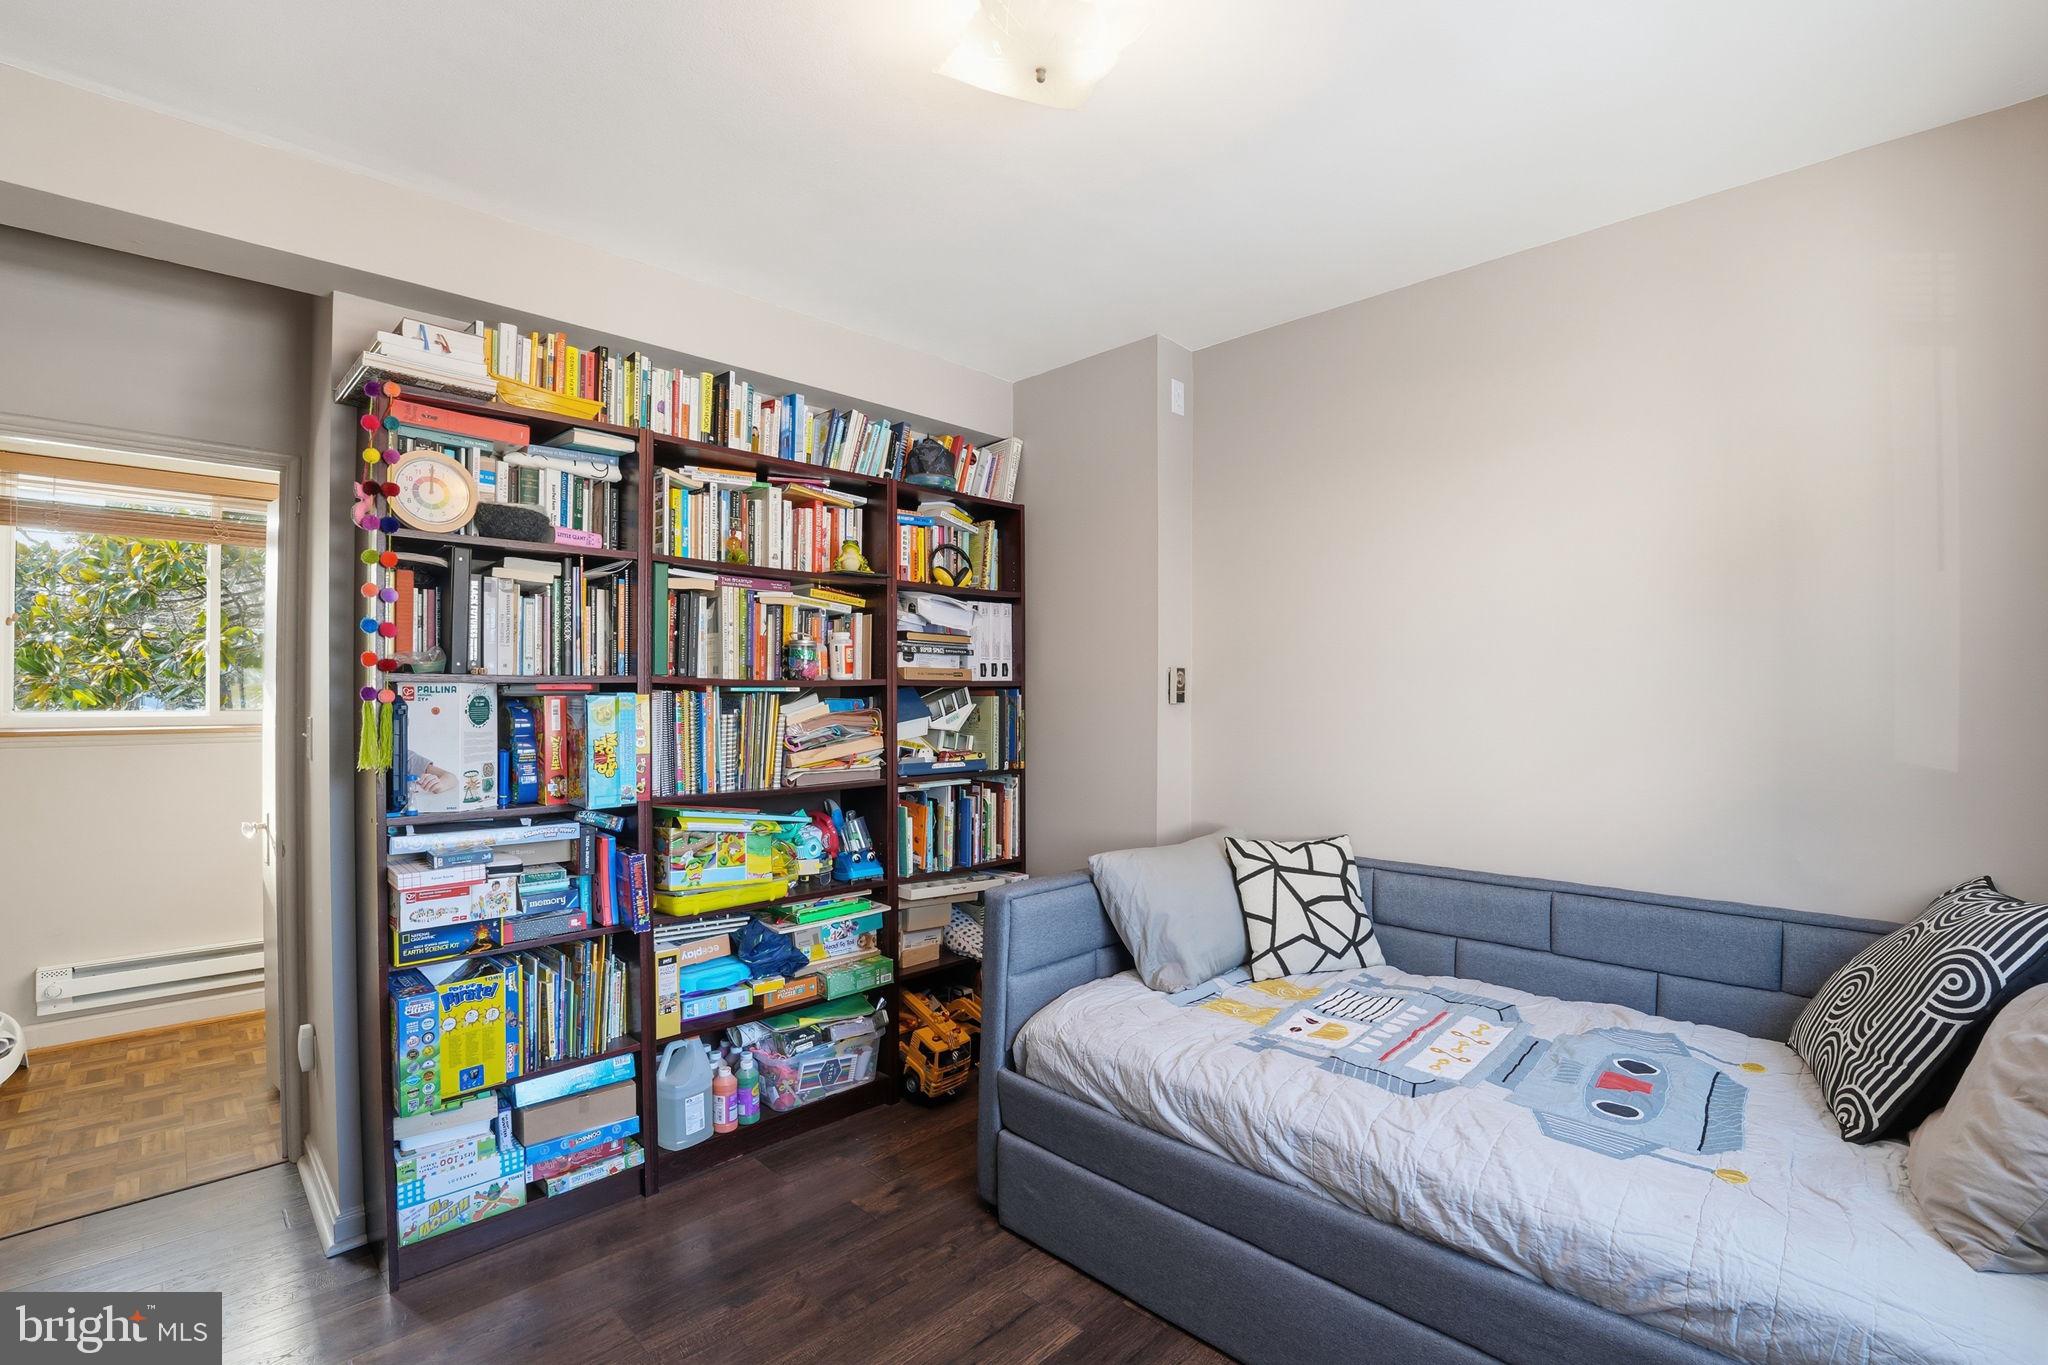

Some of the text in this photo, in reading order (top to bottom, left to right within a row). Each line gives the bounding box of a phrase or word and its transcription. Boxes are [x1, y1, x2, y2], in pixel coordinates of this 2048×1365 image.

[470, 580, 478, 638] BLACK FUTURES
[417, 686, 457, 694] PALLINA
[529, 895, 566, 908] memory
[411, 931, 430, 939] NATIONAL
[403, 948, 424, 956] EARTH
[425, 944, 448, 953] SCIENCE
[440, 1155, 459, 1167] 100
